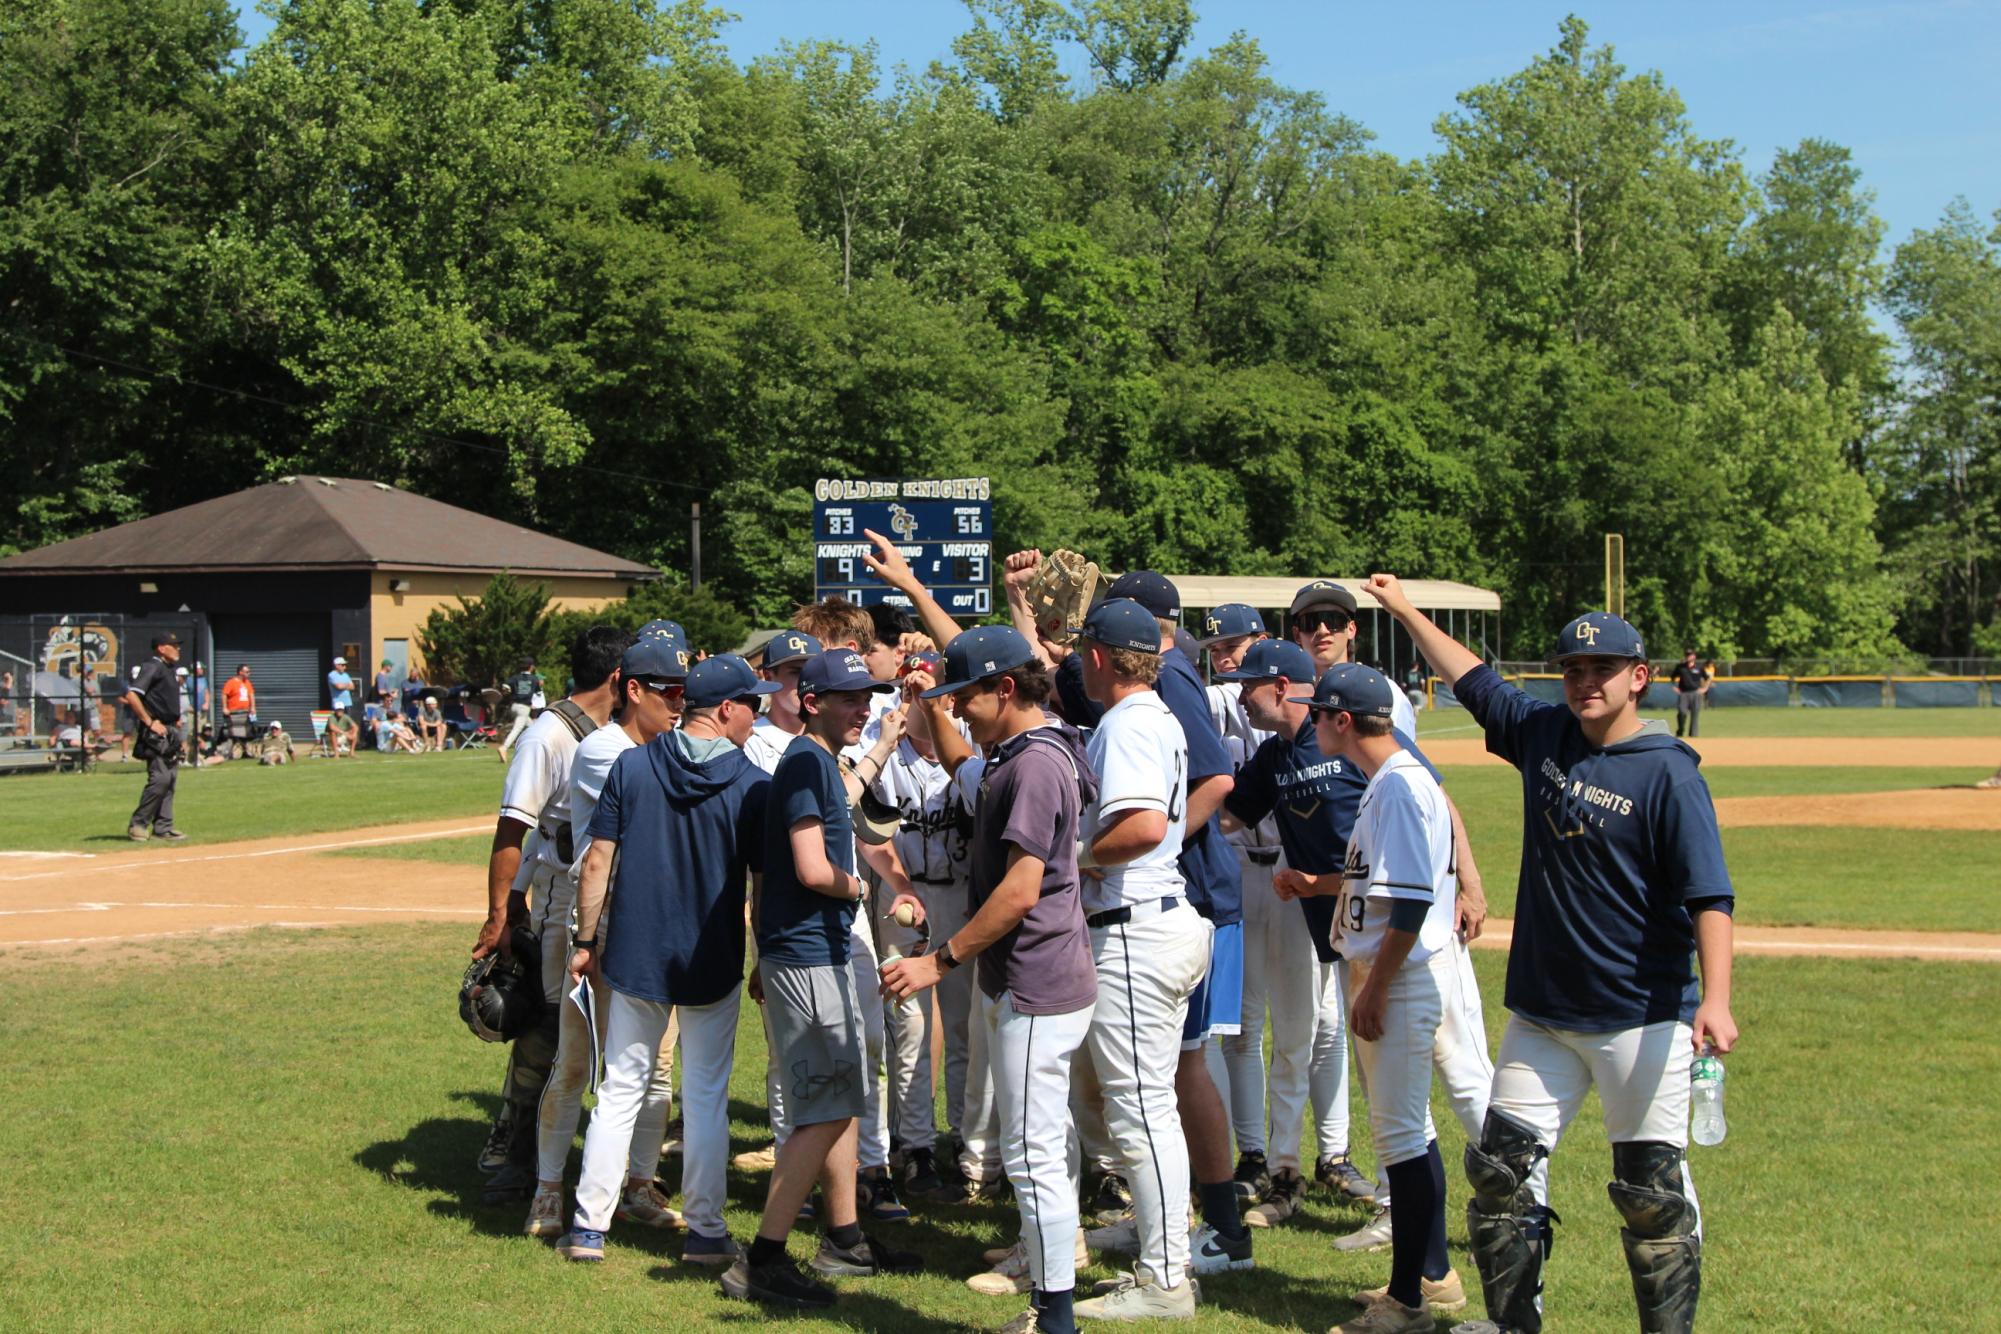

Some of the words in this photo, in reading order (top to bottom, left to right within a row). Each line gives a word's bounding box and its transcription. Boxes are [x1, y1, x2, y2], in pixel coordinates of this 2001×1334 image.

[815, 478, 898, 501] GOLDEN
[903, 477, 990, 500] KNIGHTS
[958, 516, 983, 534] 56
[817, 544, 872, 558] KNIGHTS
[942, 544, 989, 557] VISITOR
[838, 558, 853, 582] 9
[932, 560, 941, 572] E
[968, 557, 984, 581] 3
[882, 595, 914, 607] STRIK
[952, 595, 974, 606] OUT
[974, 588, 989, 613] 0
[1576, 621, 1600, 645] GT
[789, 637, 808, 654] GT
[1129, 639, 1156, 651] KNIGHTS
[1168, 748, 1188, 823] 2
[1340, 892, 1366, 933] 19
